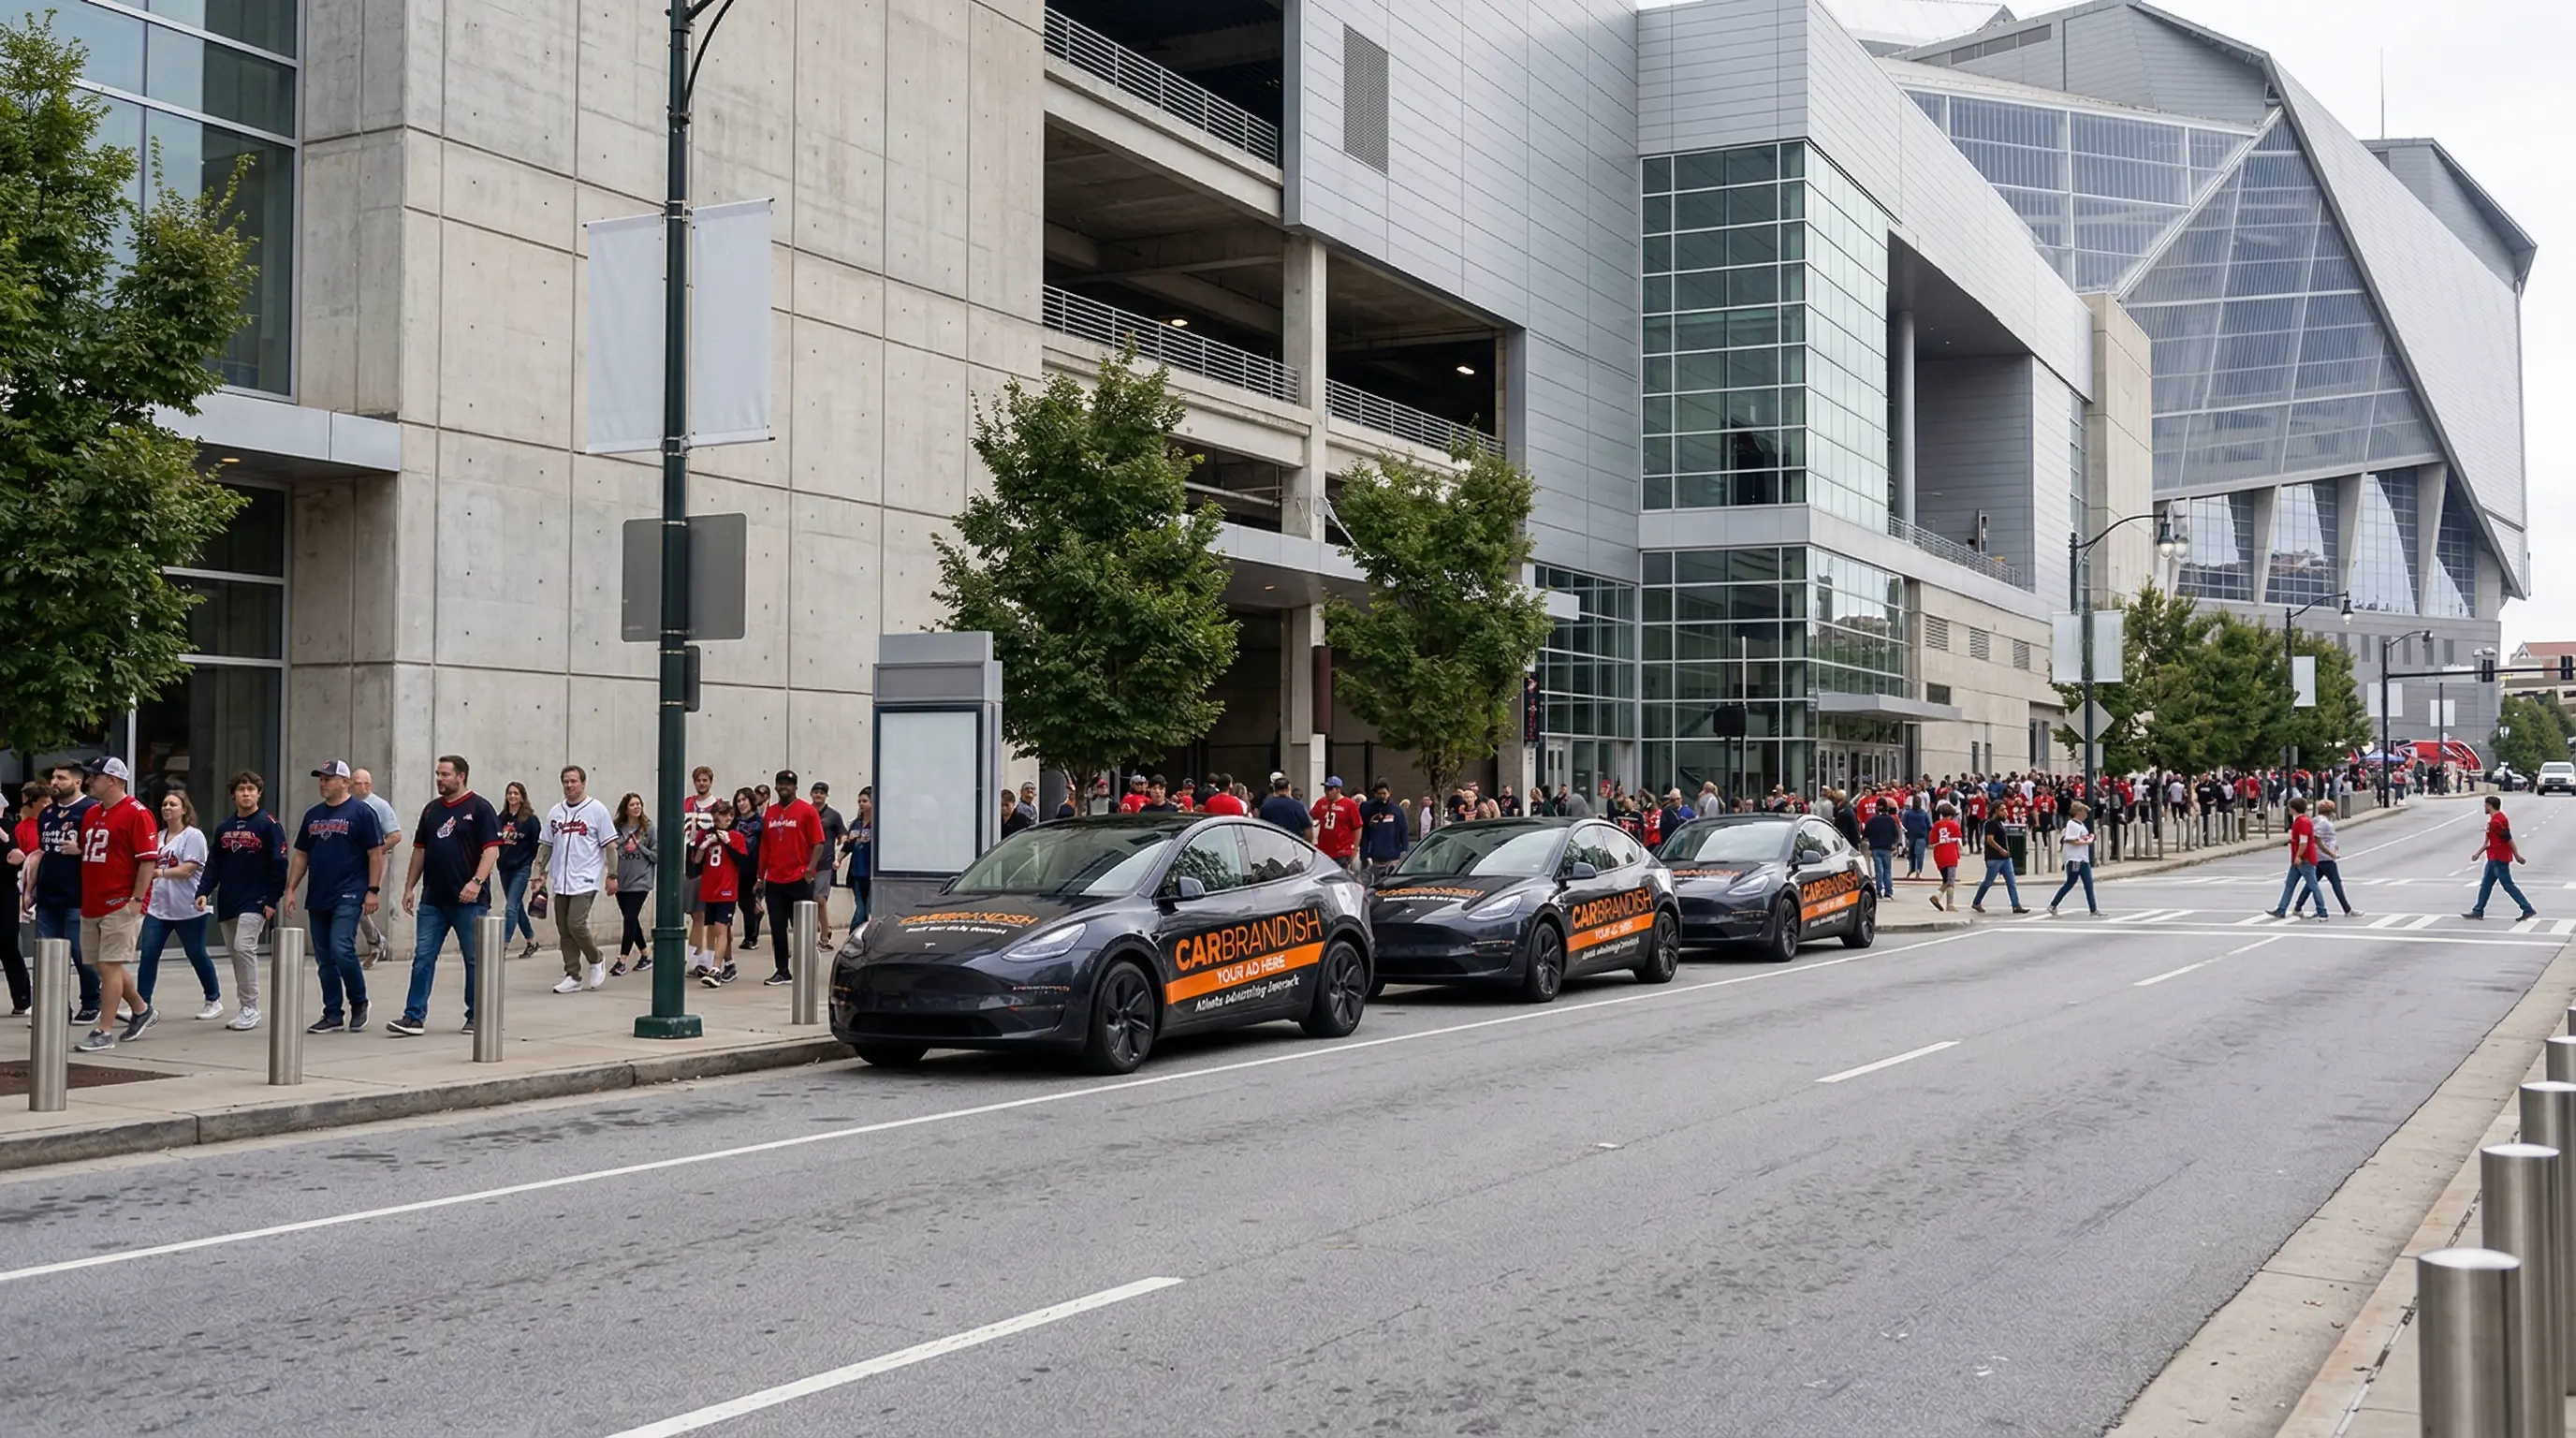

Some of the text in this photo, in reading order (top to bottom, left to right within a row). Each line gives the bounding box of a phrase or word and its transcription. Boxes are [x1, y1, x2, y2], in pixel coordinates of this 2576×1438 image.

[82, 828, 110, 862] 12
[710, 844, 723, 867] 8
[1573, 886, 1654, 929] CARBRANDISH
[1176, 908, 1323, 972] CARBRANDISH
[1217, 964, 1244, 984] YOUR
[1246, 962, 1260, 977] AD
[1261, 954, 1286, 975] HERE
